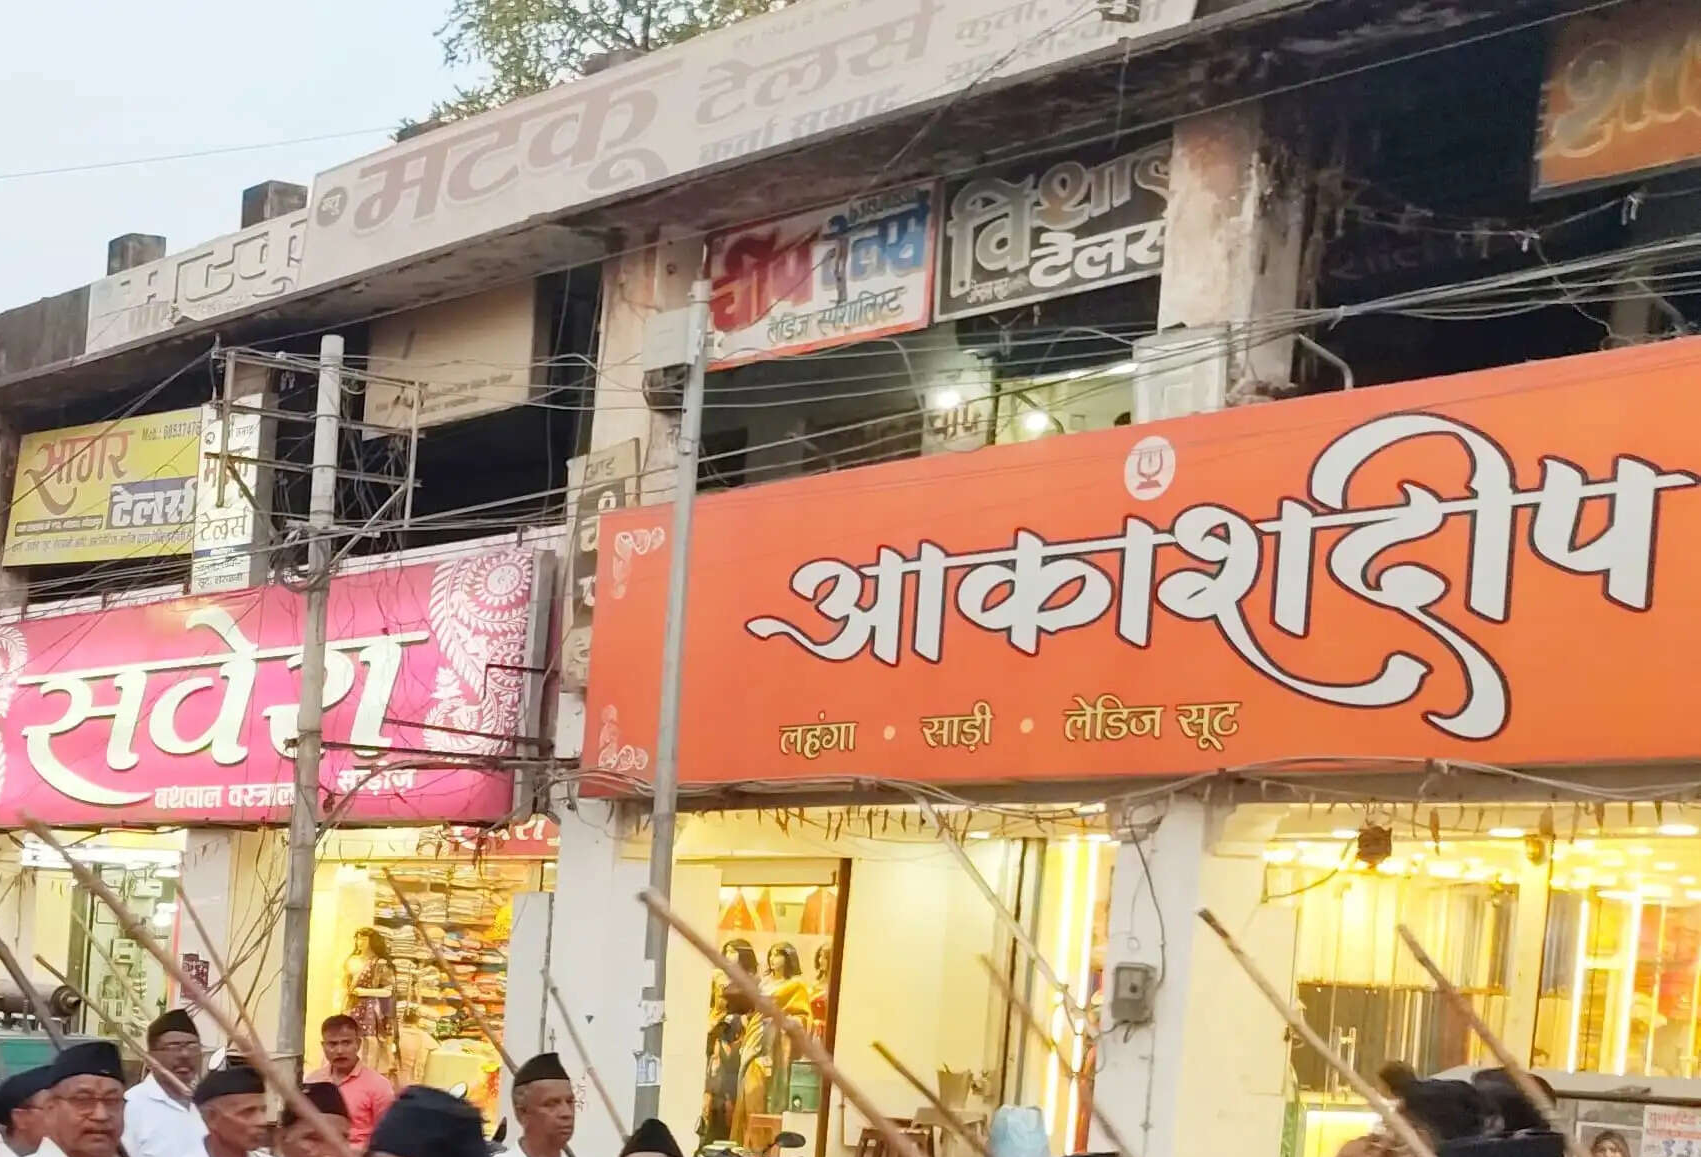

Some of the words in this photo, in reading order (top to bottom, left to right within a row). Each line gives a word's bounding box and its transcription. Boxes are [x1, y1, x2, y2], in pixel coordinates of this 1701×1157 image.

[692, 0, 939, 130] टेलर्स
[351, 60, 685, 232] मटकू
[23, 430, 135, 516] सागर
[111, 478, 199, 528] टेलर्स
[200, 505, 251, 543] टेलर्स
[744, 411, 1701, 741] आकाशदीप
[16, 604, 430, 807] सवेरा
[779, 710, 859, 761] लहंगा
[919, 700, 994, 753] साड़ी
[1062, 693, 1168, 743] लेडिज
[1175, 700, 1241, 752] सूट
[227, 781, 297, 809] वस्त्राल
